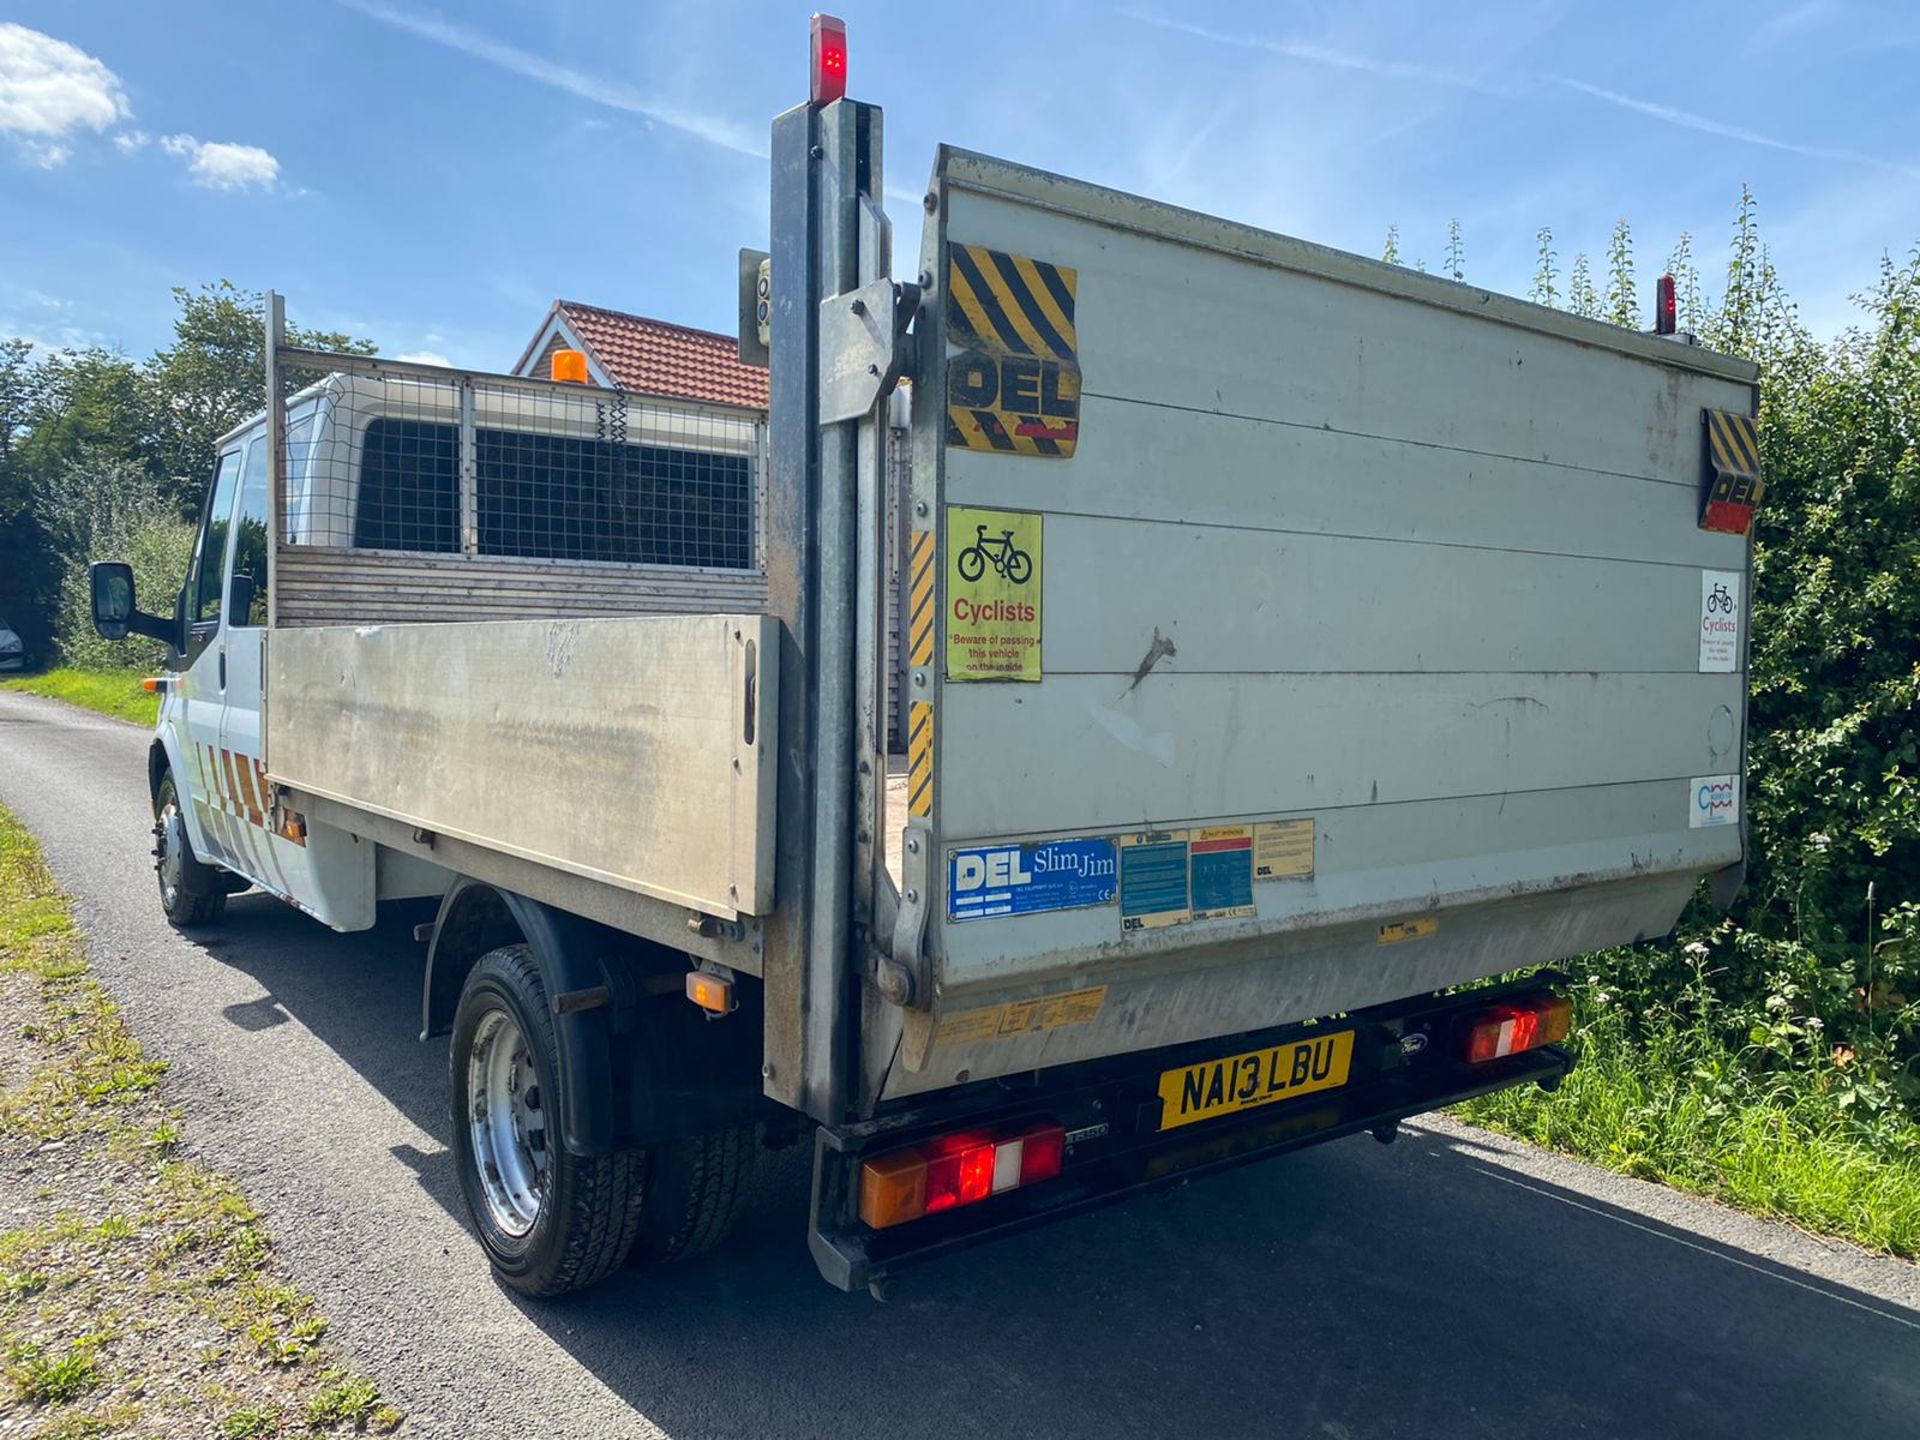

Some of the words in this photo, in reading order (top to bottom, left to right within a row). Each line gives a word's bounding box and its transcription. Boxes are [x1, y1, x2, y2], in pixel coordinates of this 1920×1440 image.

[950, 350, 1077, 419] DEL
[1711, 470, 1758, 506] DEL
[954, 598, 1035, 626] Cyclists
[1703, 616, 1735, 636] Cyclists
[953, 634, 987, 645] Beware
[989, 635, 999, 645] of
[1000, 636, 1035, 648] passing
[969, 648, 986, 658] this
[988, 648, 1020, 659] vehicle
[980, 663, 993, 672] the
[995, 664, 1023, 672] inside
[956, 850, 1032, 892] DEL
[1034, 848, 1079, 873] Slim
[1078, 853, 1115, 878] Jim
[1257, 866, 1273, 876] DEL
[1124, 918, 1145, 931] DEL
[1180, 1056, 1261, 1115] NA13
[1267, 1039, 1335, 1093] LBU
